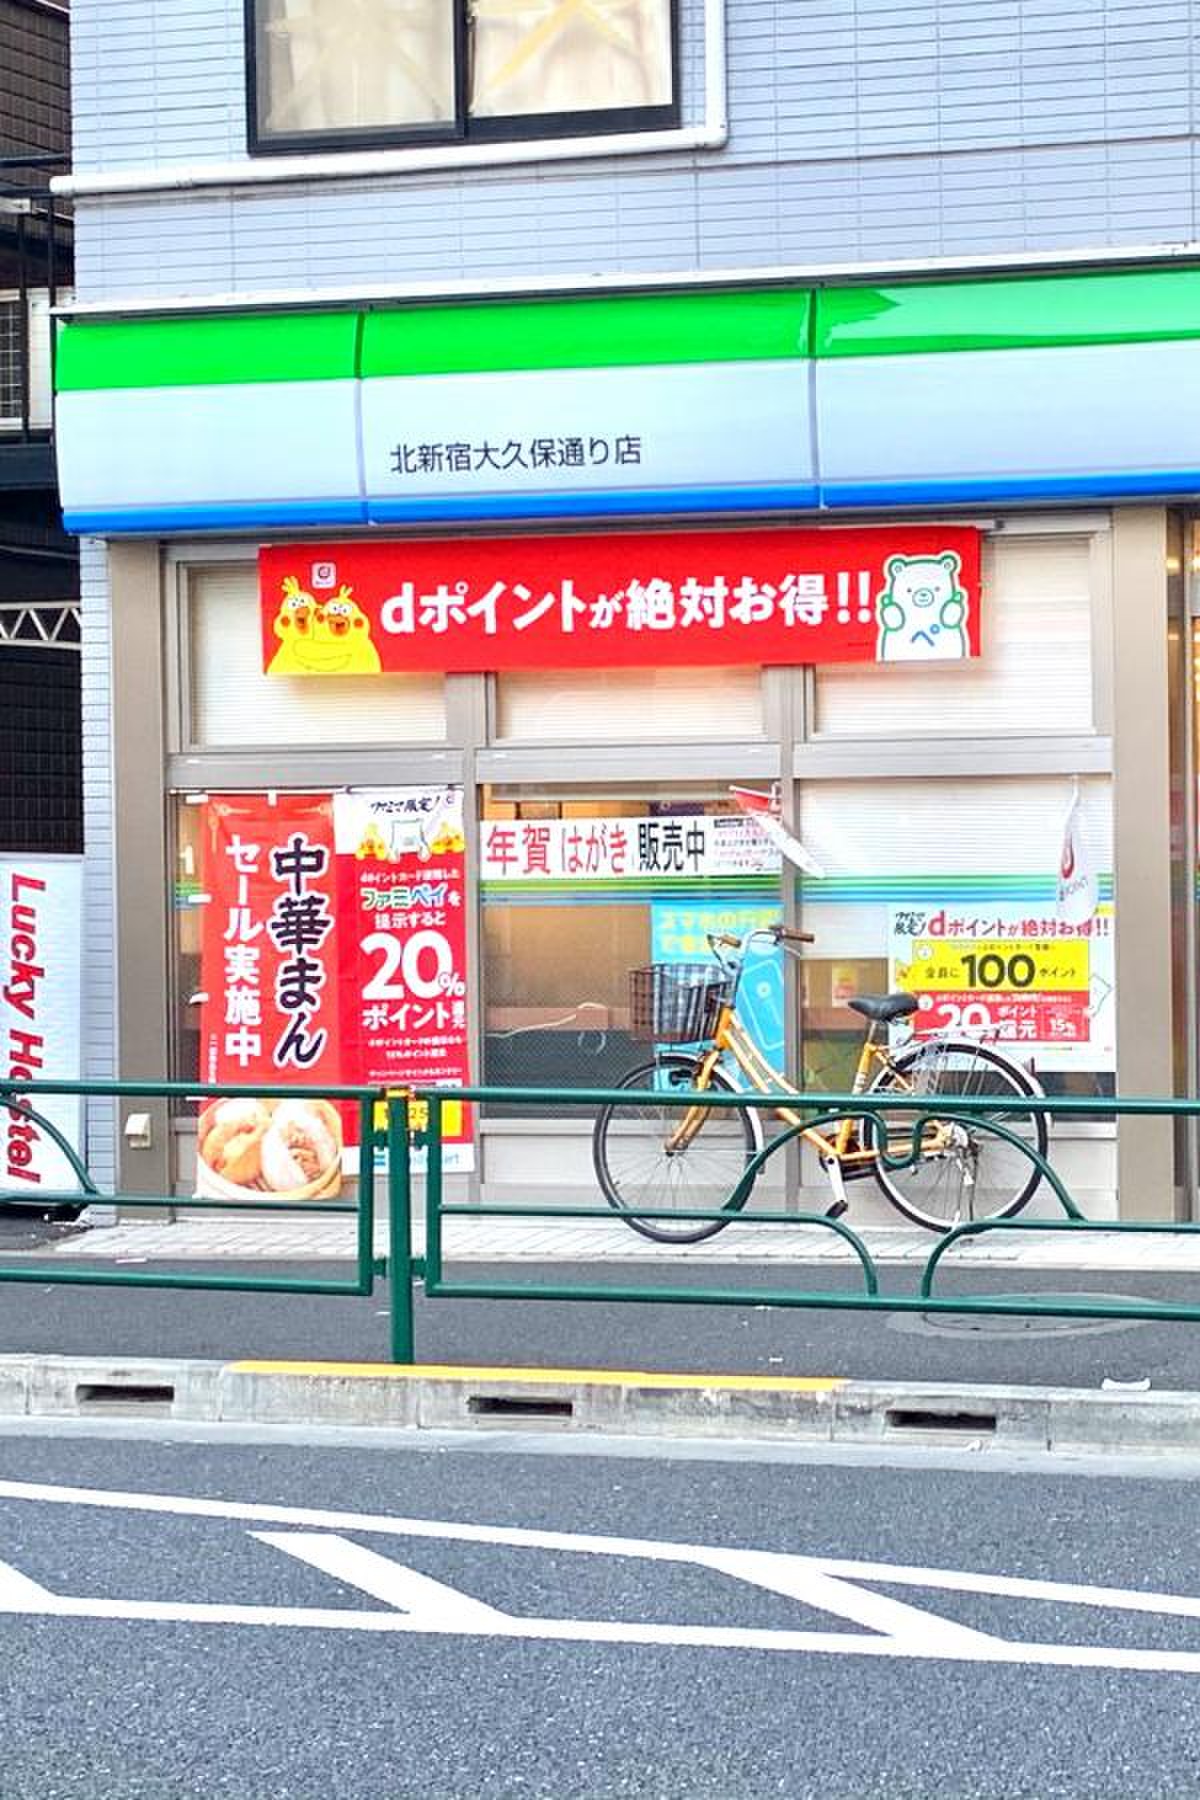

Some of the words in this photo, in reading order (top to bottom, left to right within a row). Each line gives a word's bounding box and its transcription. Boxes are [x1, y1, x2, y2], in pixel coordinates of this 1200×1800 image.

[390, 435, 641, 474] 北新宿大久保通り店
[381, 571, 871, 634] dポイントが絶対お得!!
[4, 873, 46, 1019] Lucky
[223, 834, 264, 1067] セール実施中
[268, 832, 336, 1070] 中華まん
[359, 929, 465, 1000] 20%
[960, 953, 1036, 988] 100
